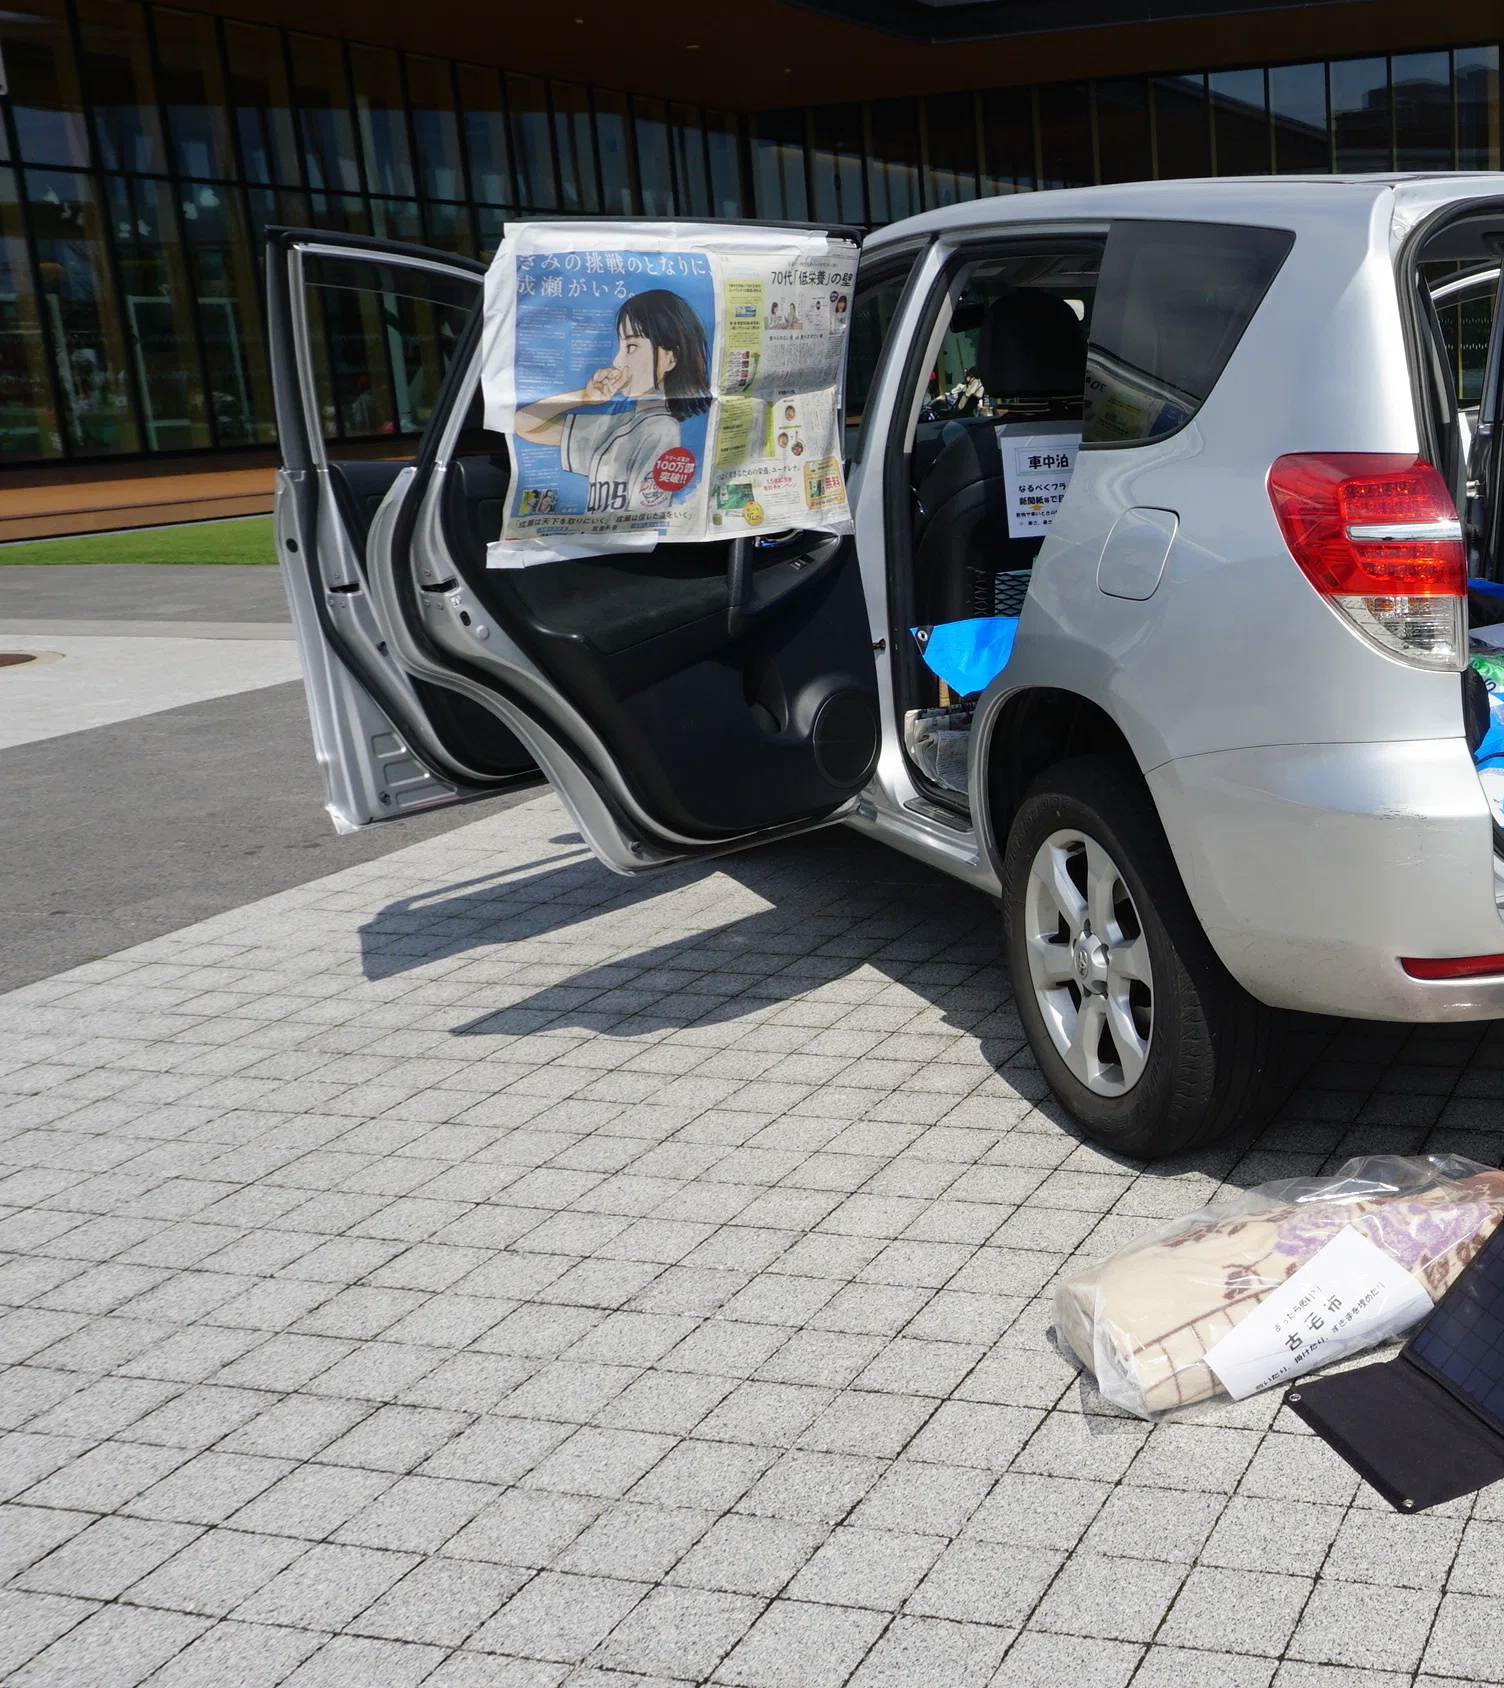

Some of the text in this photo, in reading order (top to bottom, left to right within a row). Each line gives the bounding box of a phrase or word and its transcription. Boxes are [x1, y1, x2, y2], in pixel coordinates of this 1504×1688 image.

[517, 275, 634, 298] 成瀬がいる。
[656, 460, 695, 473] 100万部
[1028, 454, 1069, 469] 車中泊
[1284, 1294, 1344, 1351] 古毛布
